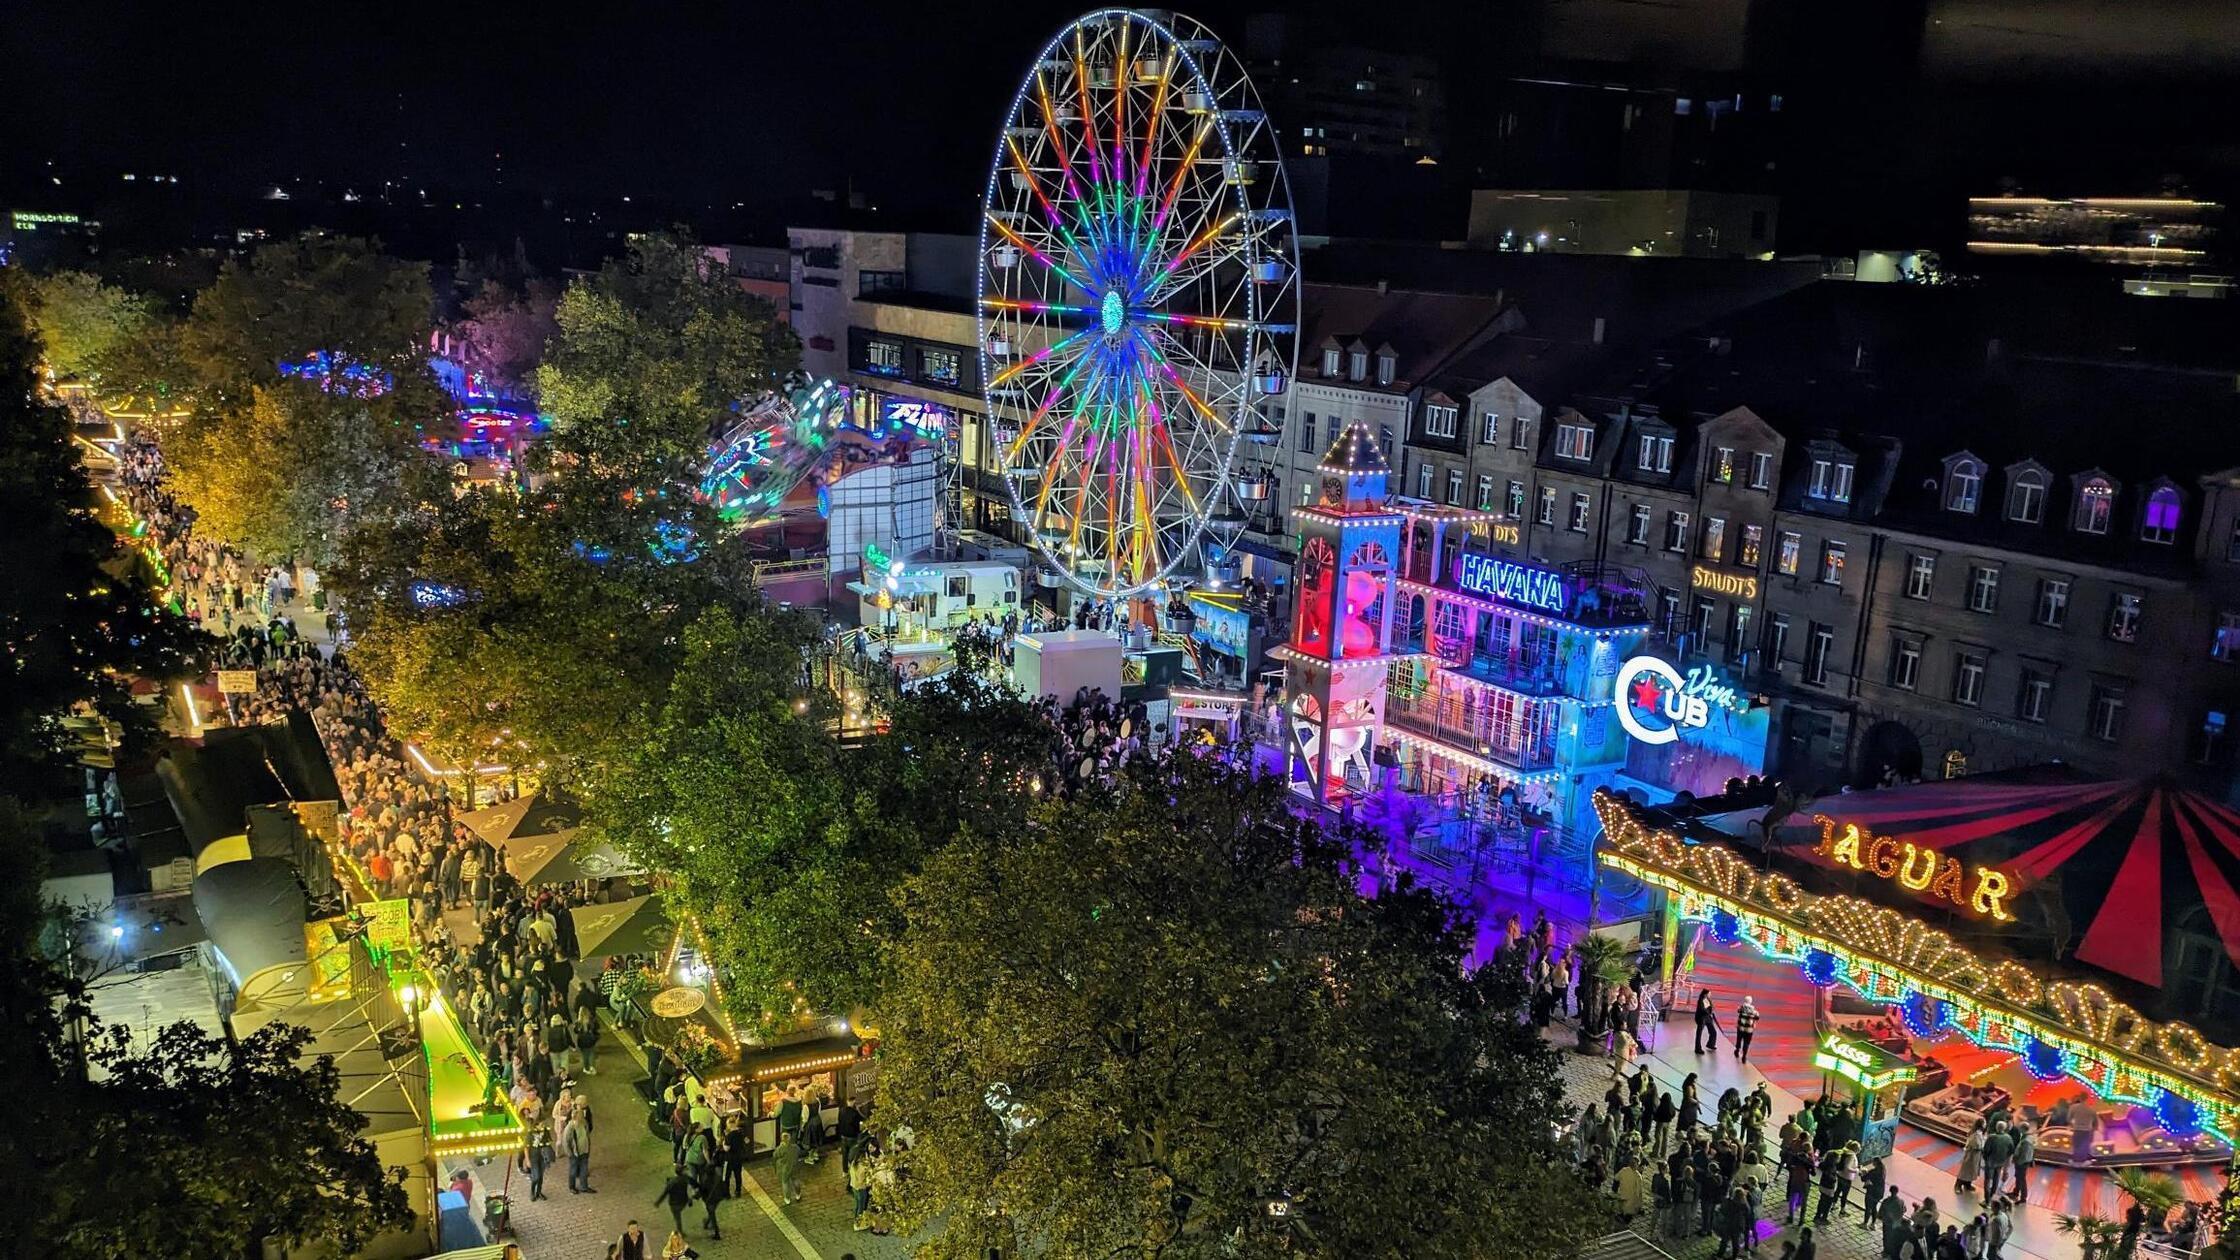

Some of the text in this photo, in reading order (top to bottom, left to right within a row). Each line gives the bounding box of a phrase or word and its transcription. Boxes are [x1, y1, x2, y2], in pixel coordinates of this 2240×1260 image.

[1460, 553, 1563, 612] HAVANA
[1687, 664, 1734, 707] Viva
[1812, 814, 2014, 921] JAGUAR
[1823, 1034, 1873, 1068] Kasse
